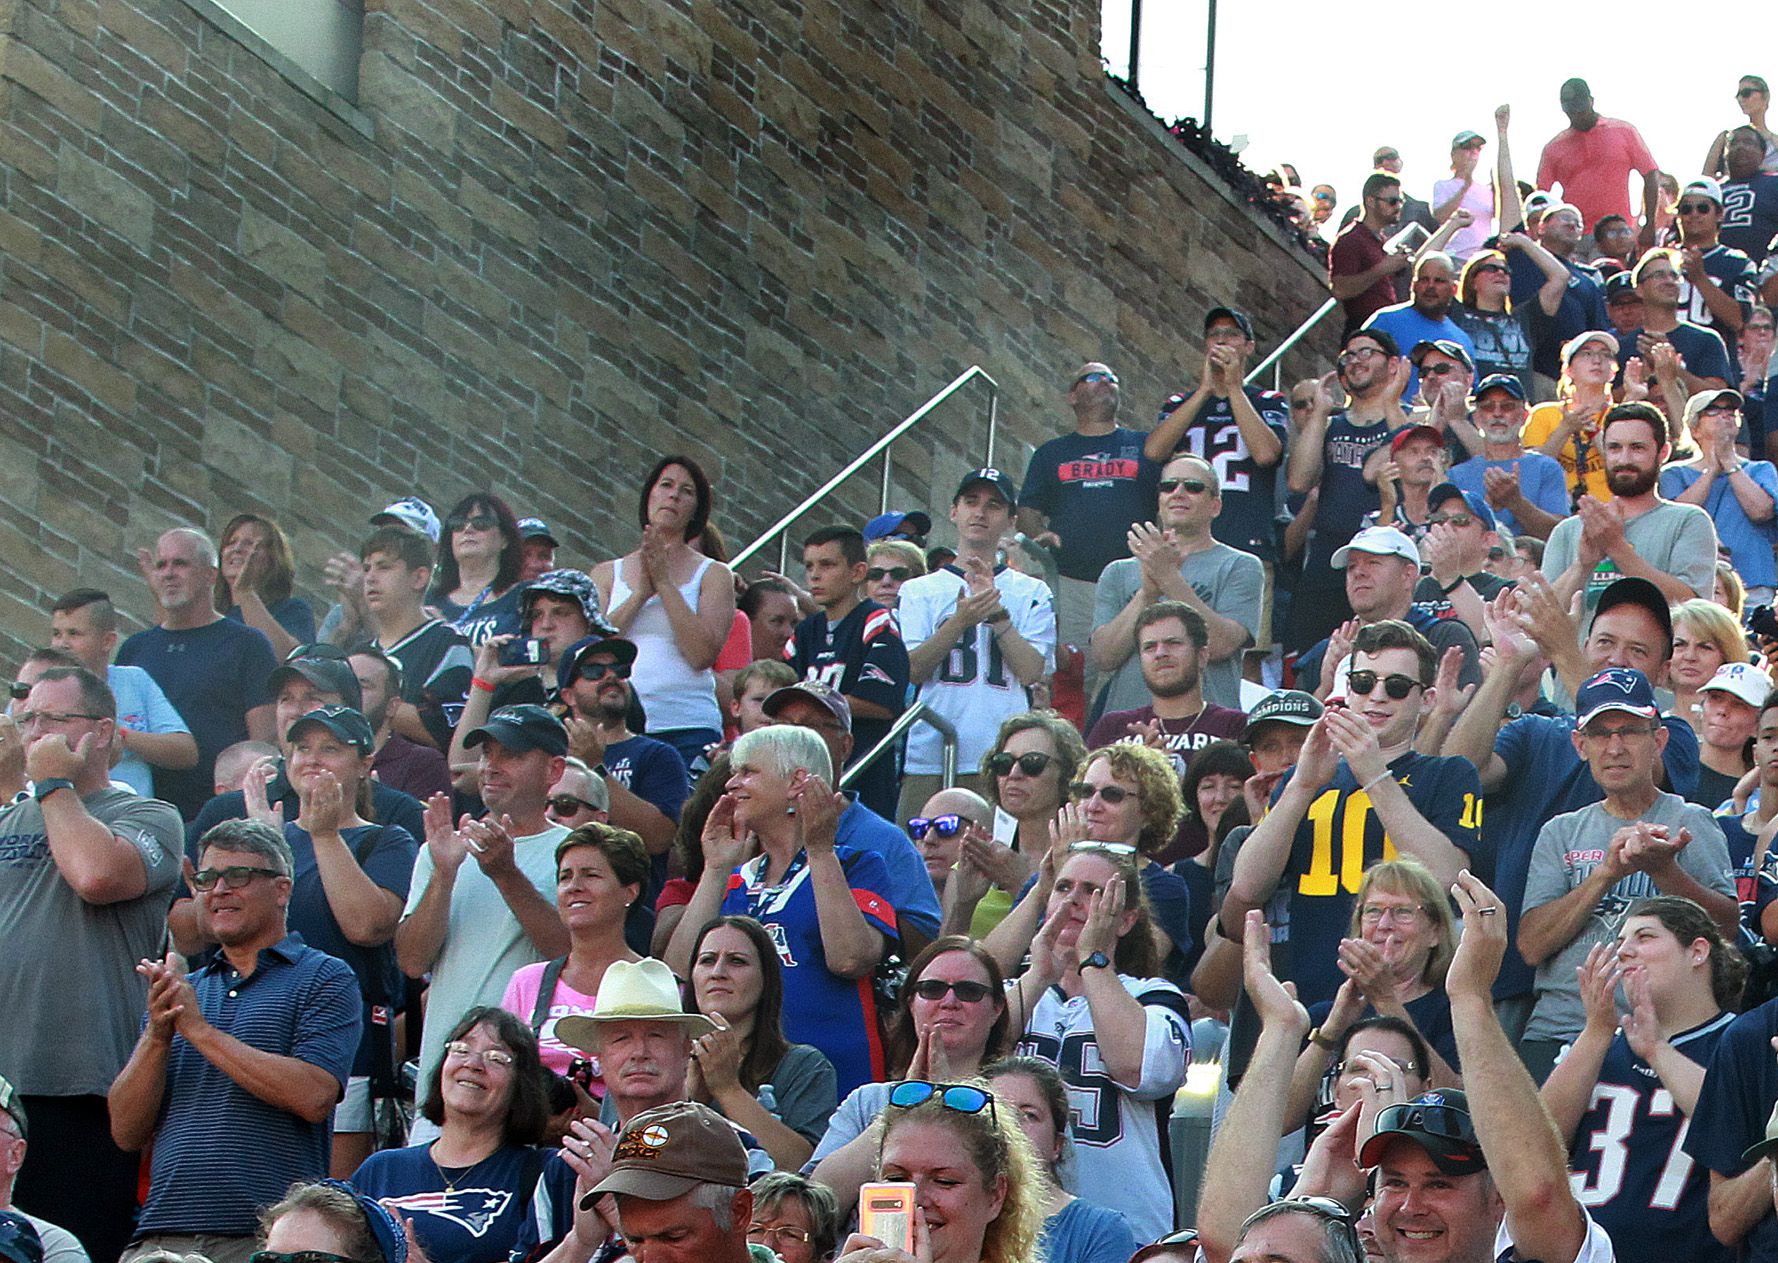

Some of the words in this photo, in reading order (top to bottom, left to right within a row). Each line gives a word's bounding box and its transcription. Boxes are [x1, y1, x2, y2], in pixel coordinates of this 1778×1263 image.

[979, 467, 1000, 482] 12
[1071, 462, 1125, 480] BRADY
[1185, 424, 1251, 493] 12
[1298, 788, 1399, 897] 10
[1563, 849, 1604, 867] SPER
[1567, 1081, 1697, 1209] 37
